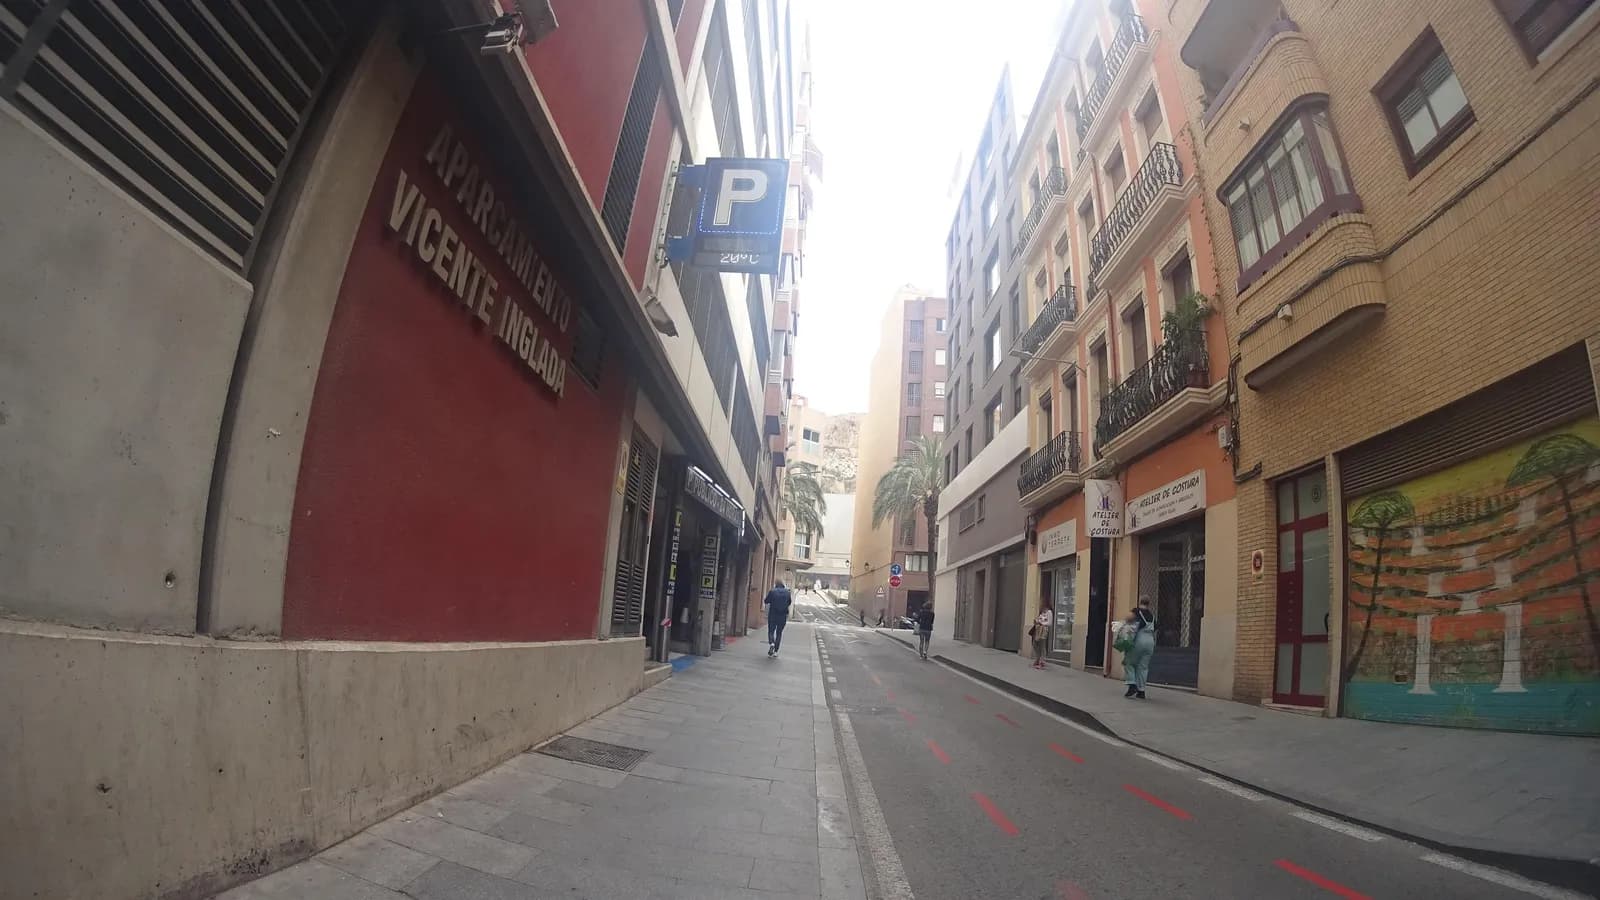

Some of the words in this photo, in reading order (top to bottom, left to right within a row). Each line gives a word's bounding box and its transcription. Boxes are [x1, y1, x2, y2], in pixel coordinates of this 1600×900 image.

[713, 168, 769, 227] P
[425, 124, 572, 334] APARCAMIENTO
[387, 168, 499, 323] VICENTE
[499, 295, 568, 398] INGLADA
[1140, 491, 1162, 507] ATELIER
[1162, 488, 1171, 499] DE
[1172, 476, 1200, 496] COSTURA
[1092, 511, 1120, 519] ATELIER
[1091, 527, 1120, 536] COSTURA
[704, 577, 711, 585] P
